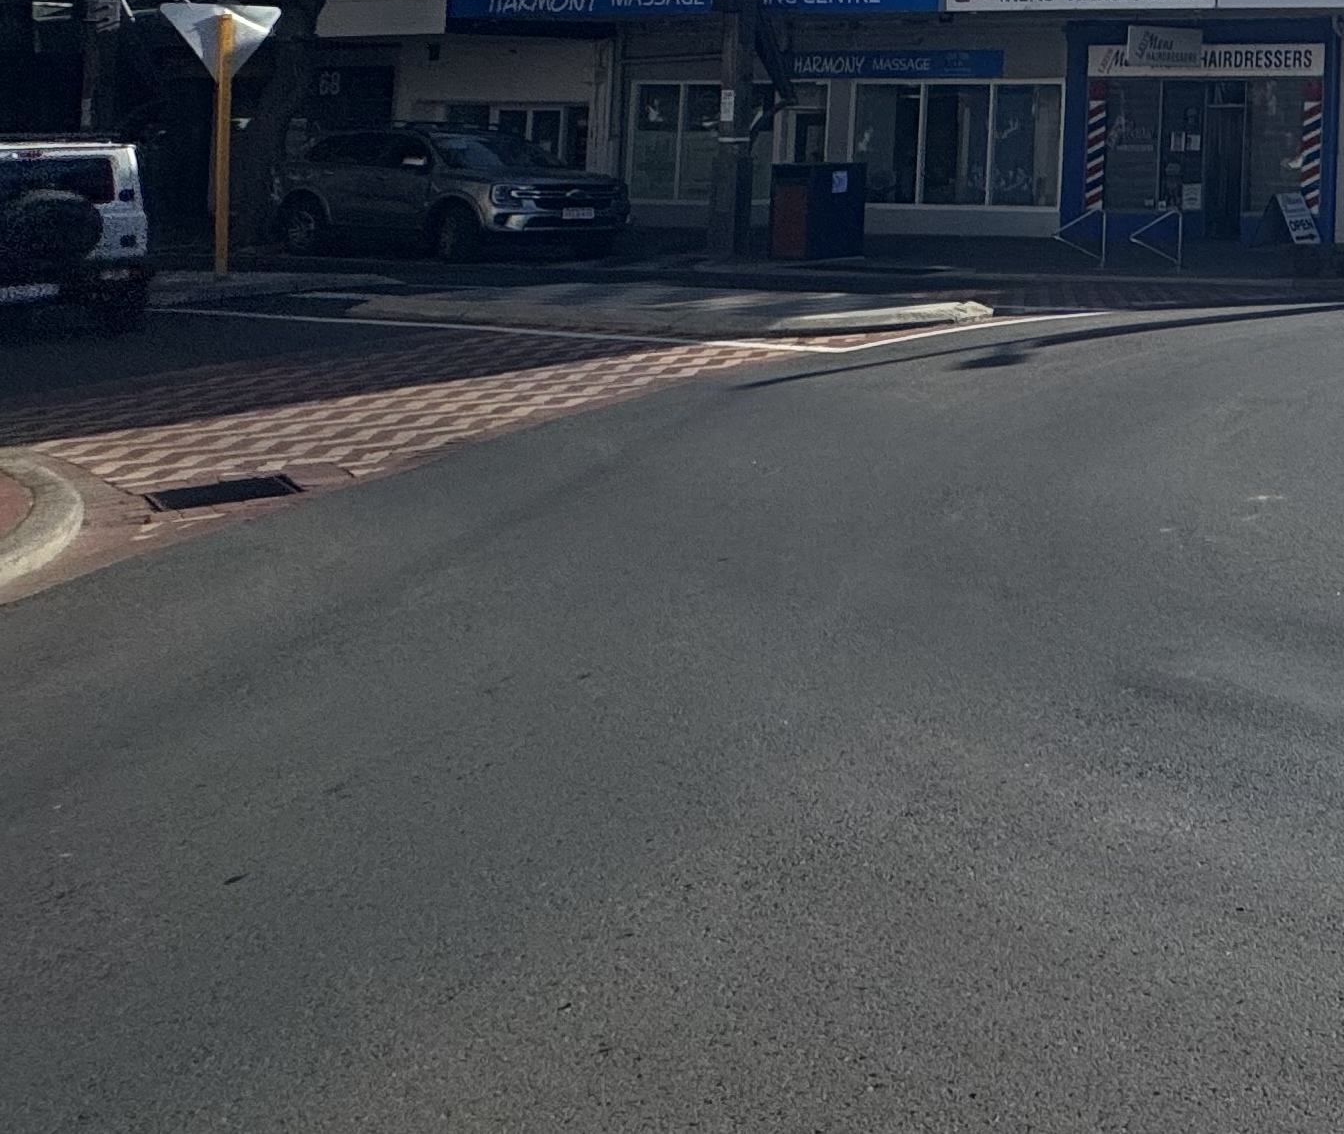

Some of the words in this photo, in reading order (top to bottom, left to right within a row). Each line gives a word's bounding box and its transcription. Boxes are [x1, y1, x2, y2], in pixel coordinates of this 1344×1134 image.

[793, 54, 866, 75] HARMONY
[872, 57, 931, 72] MASSAGE
[1289, 218, 1314, 232] OPEN
